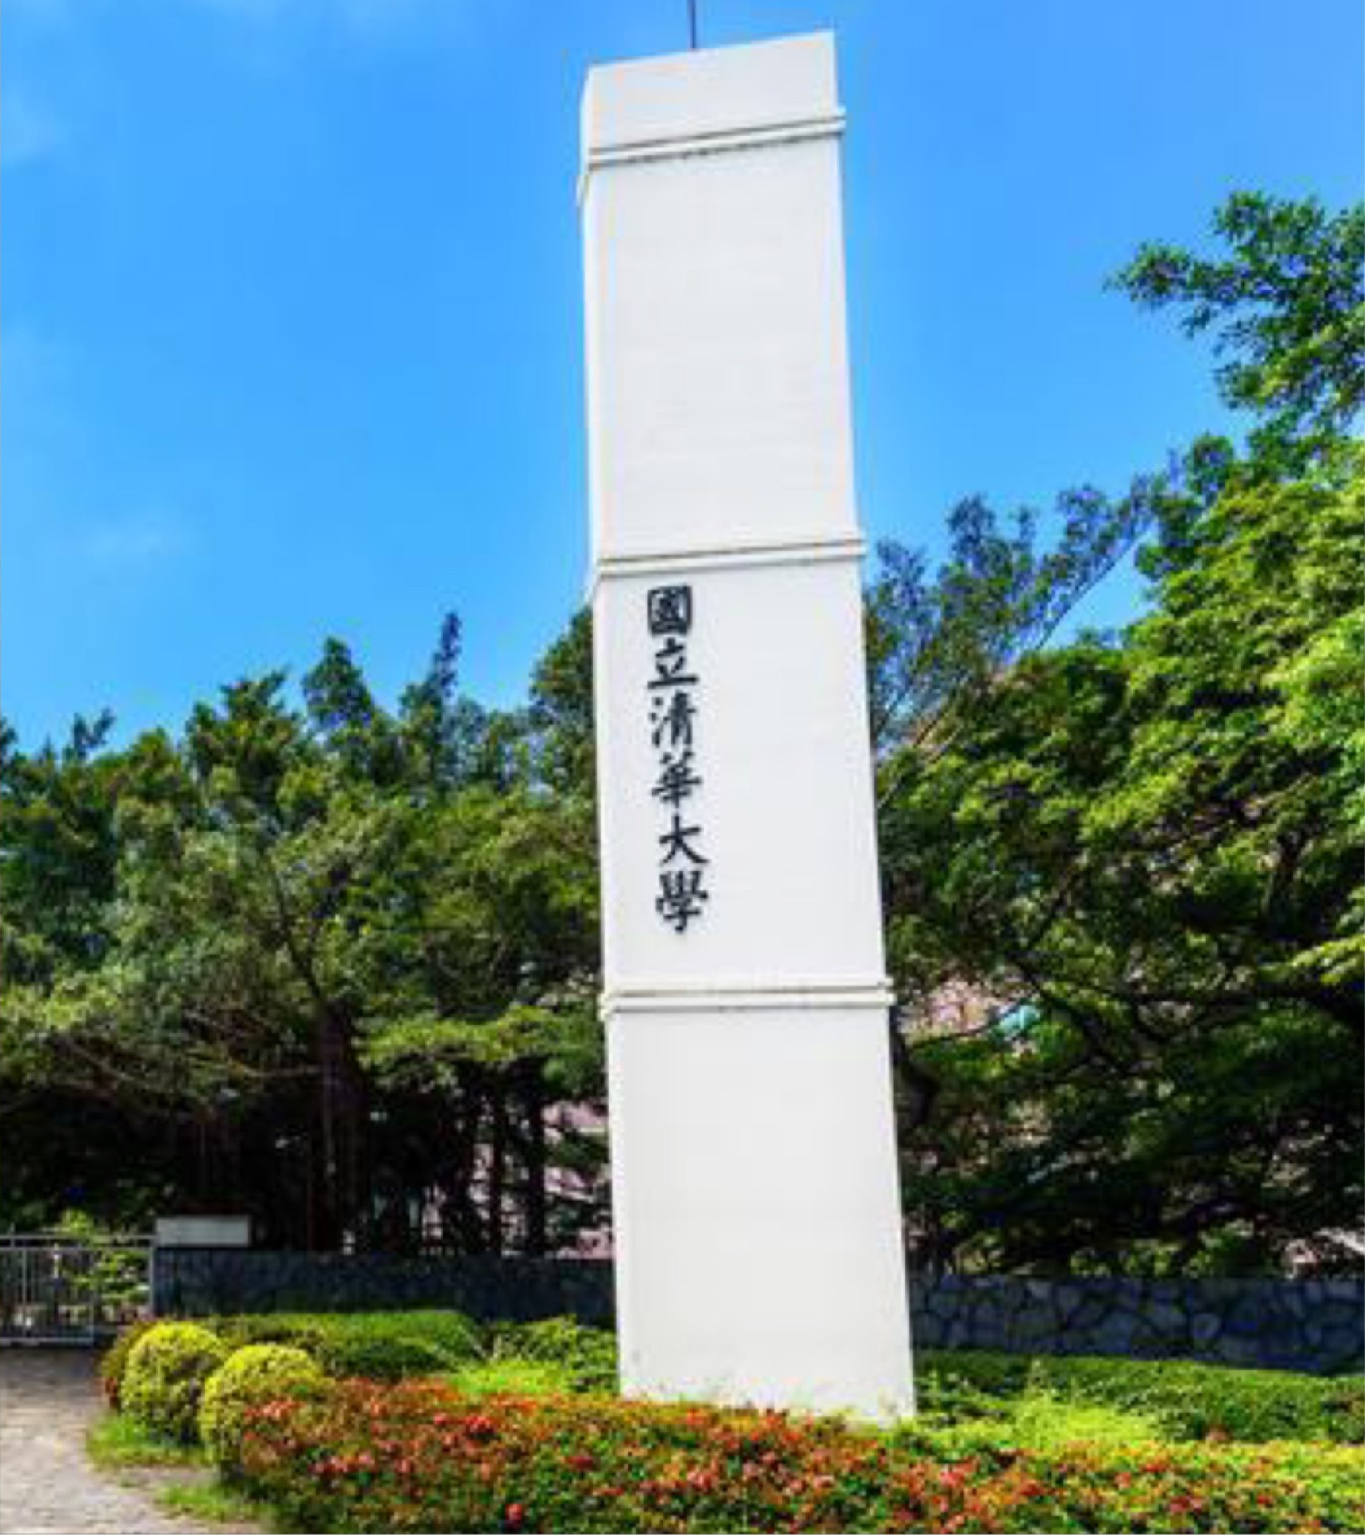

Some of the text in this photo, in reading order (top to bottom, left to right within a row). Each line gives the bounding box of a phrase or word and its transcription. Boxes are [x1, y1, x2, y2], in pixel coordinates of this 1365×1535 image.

[647, 584, 709, 934] 國立清華大學
